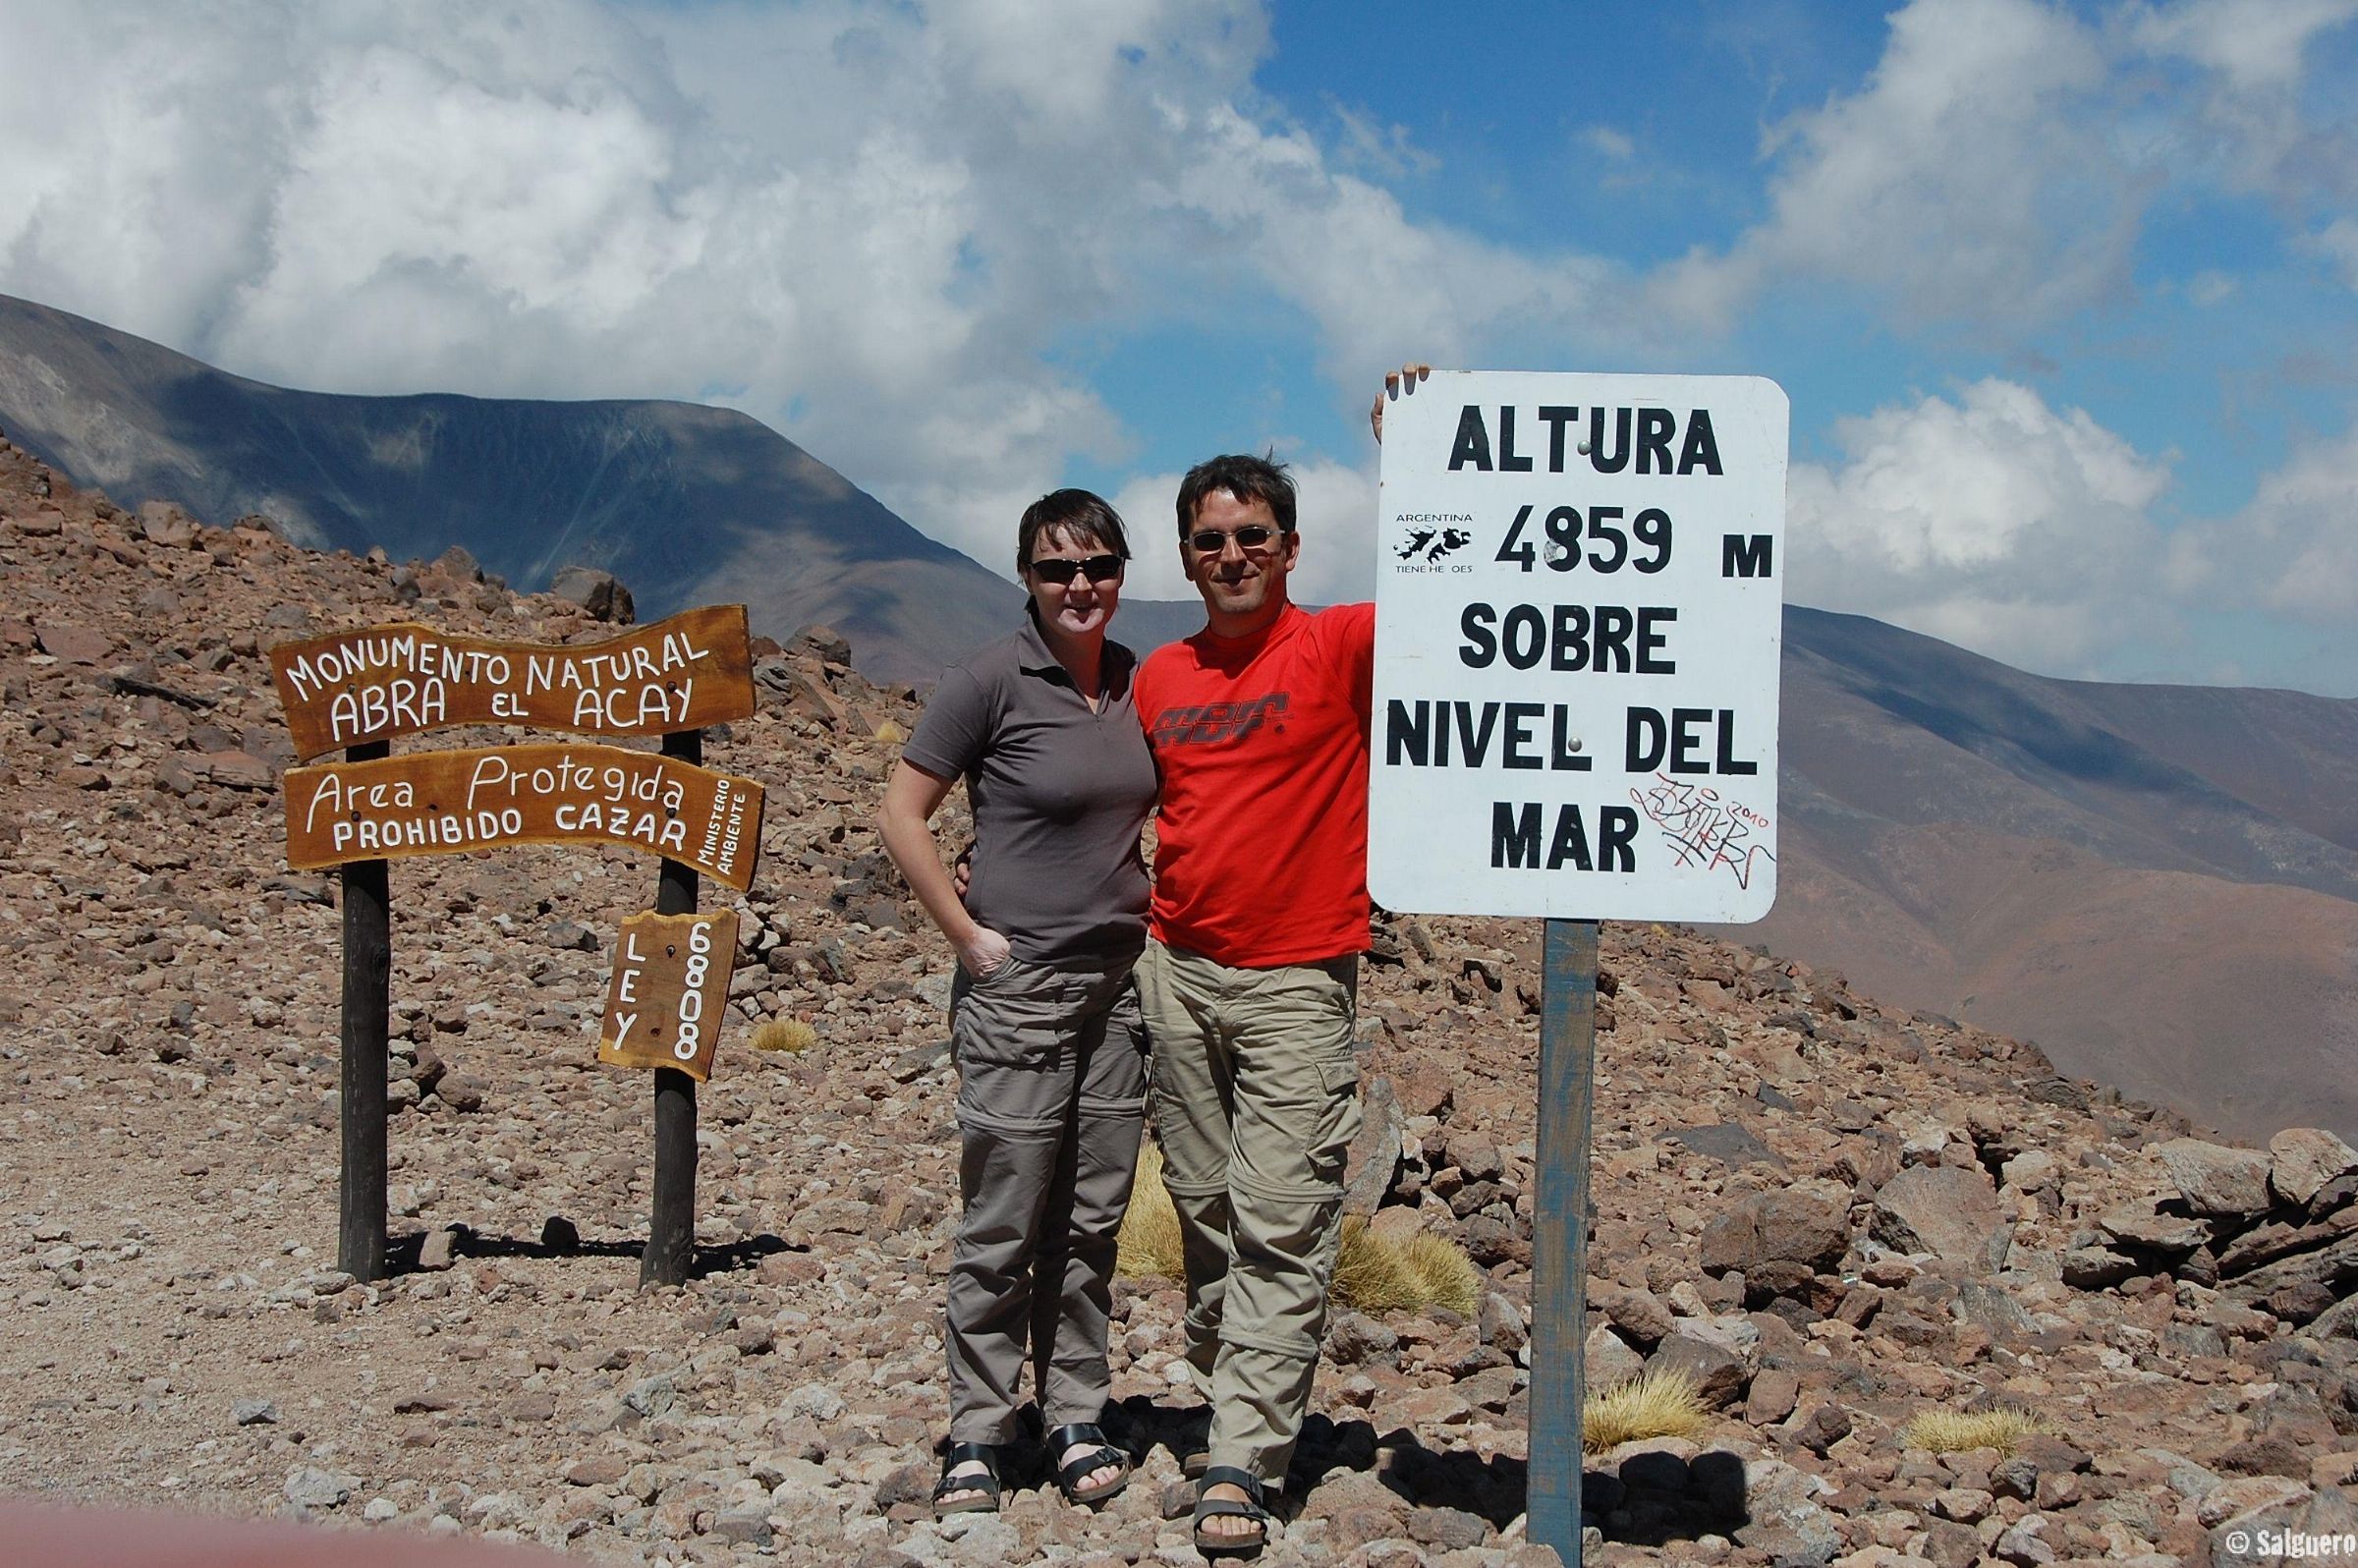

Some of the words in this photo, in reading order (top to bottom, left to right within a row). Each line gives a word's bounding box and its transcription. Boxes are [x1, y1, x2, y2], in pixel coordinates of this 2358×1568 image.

[1447, 405, 1724, 476] ALTURA
[1395, 514, 1474, 523] ARGENTINA
[1494, 505, 1672, 574] 4859
[1721, 533, 1773, 578] M
[1395, 565, 1427, 574] TIENE
[1429, 565, 1474, 574] HEOES
[287, 635, 510, 701] MONUMENTO
[526, 632, 709, 695] NATURAL
[1458, 602, 1678, 675] SOBRE
[331, 676, 445, 743] ABRA
[492, 692, 530, 717] EL
[573, 678, 693, 729] ACAY
[1386, 700, 1593, 772] NIVEL
[1625, 706, 1758, 776] DEL
[306, 773, 415, 833] Area
[467, 755, 685, 812] Protegida
[333, 808, 523, 852] PROHIBIDO
[555, 803, 687, 853] CAZAR
[1731, 801, 1769, 828] 2010
[716, 793, 747, 875] AMBIENTE
[1490, 802, 1640, 873] MAR
[613, 932, 646, 1051] LEY
[673, 922, 711, 1061] 6808
